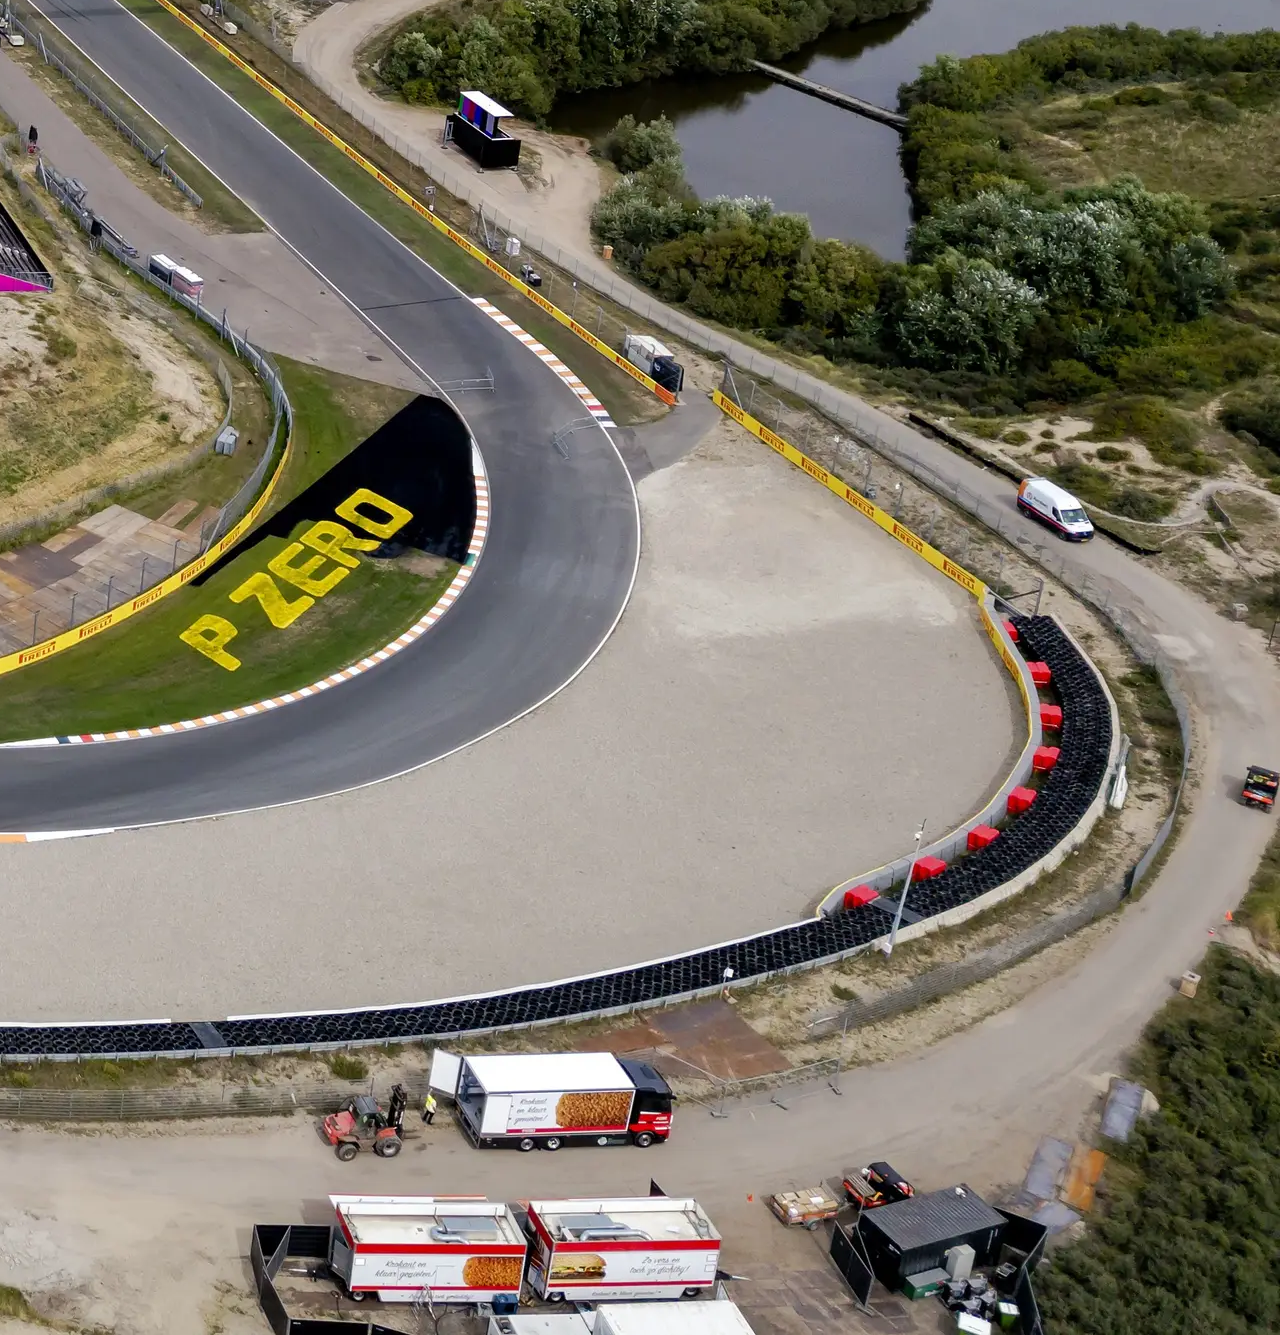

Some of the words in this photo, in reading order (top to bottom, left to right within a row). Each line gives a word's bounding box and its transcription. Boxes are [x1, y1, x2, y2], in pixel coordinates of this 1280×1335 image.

[721, 396, 745, 420] PIRELLI
[759, 426, 785, 454] PIRELLI
[802, 456, 828, 485] PIRELLI
[846, 487, 874, 517] PIRELLI
[893, 522, 922, 554] PIRELLI
[179, 613, 241, 671] P
[229, 488, 414, 629] ZERO
[180, 557, 206, 583] PIRELLI
[942, 559, 976, 590] PIRELLI
[132, 586, 162, 611] PIRELLI
[79, 614, 113, 640] PIRELLI
[18, 641, 56, 665] PIRELLI
